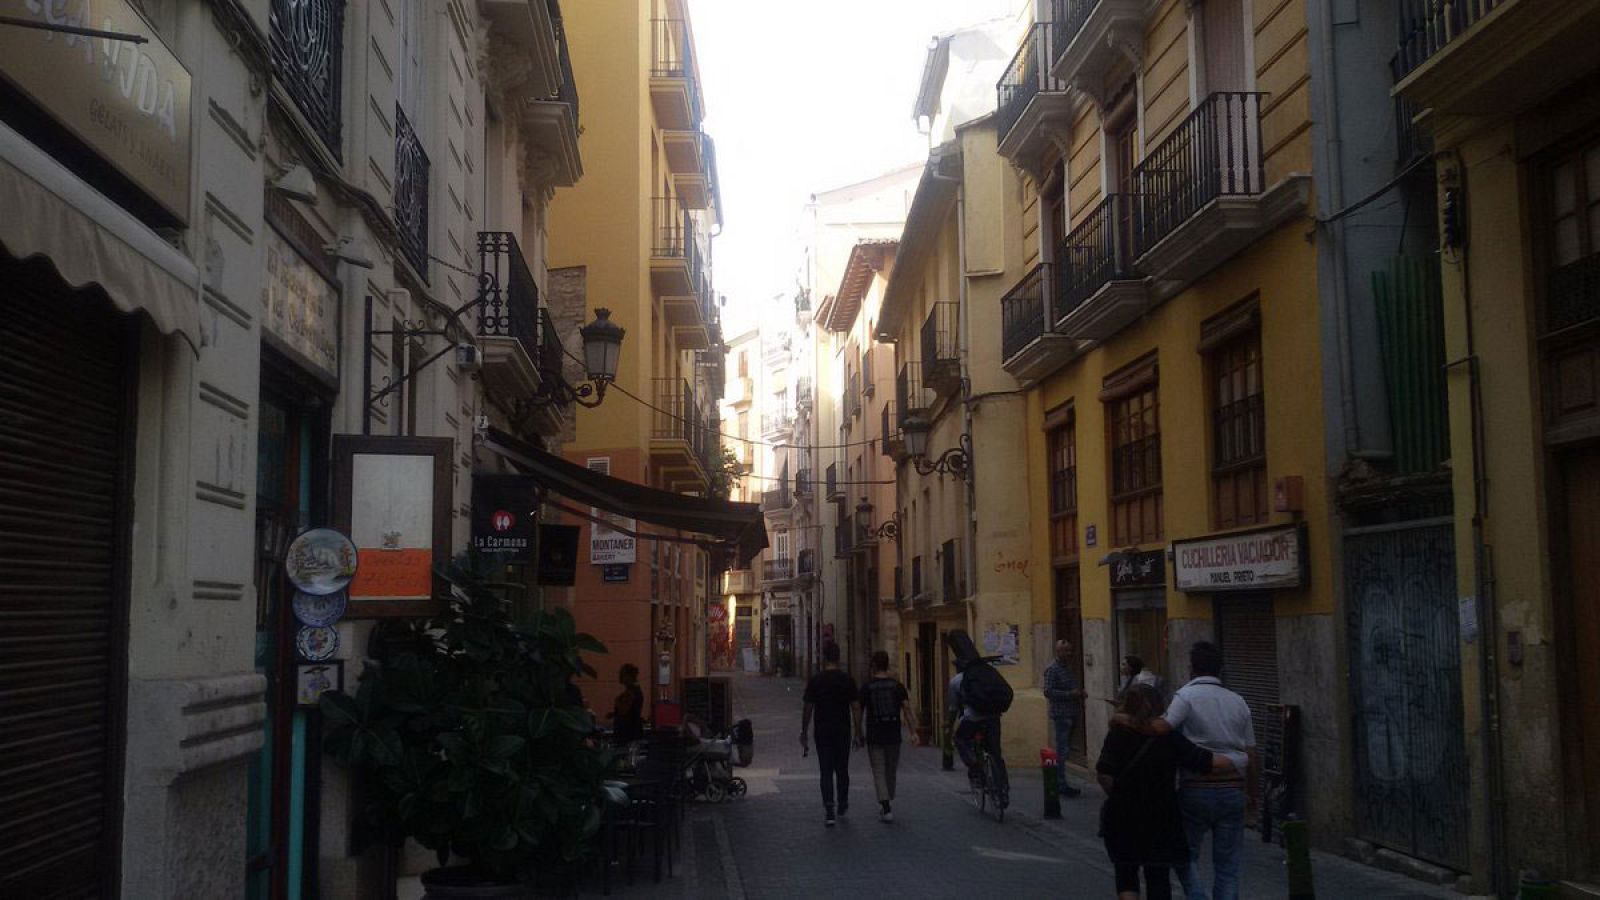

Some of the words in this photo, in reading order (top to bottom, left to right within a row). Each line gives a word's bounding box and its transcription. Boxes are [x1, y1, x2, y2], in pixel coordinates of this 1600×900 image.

[592, 538, 634, 550] MONTANER
[1210, 571, 1231, 583] MANUEL
[1233, 569, 1255, 583] PRIETO
